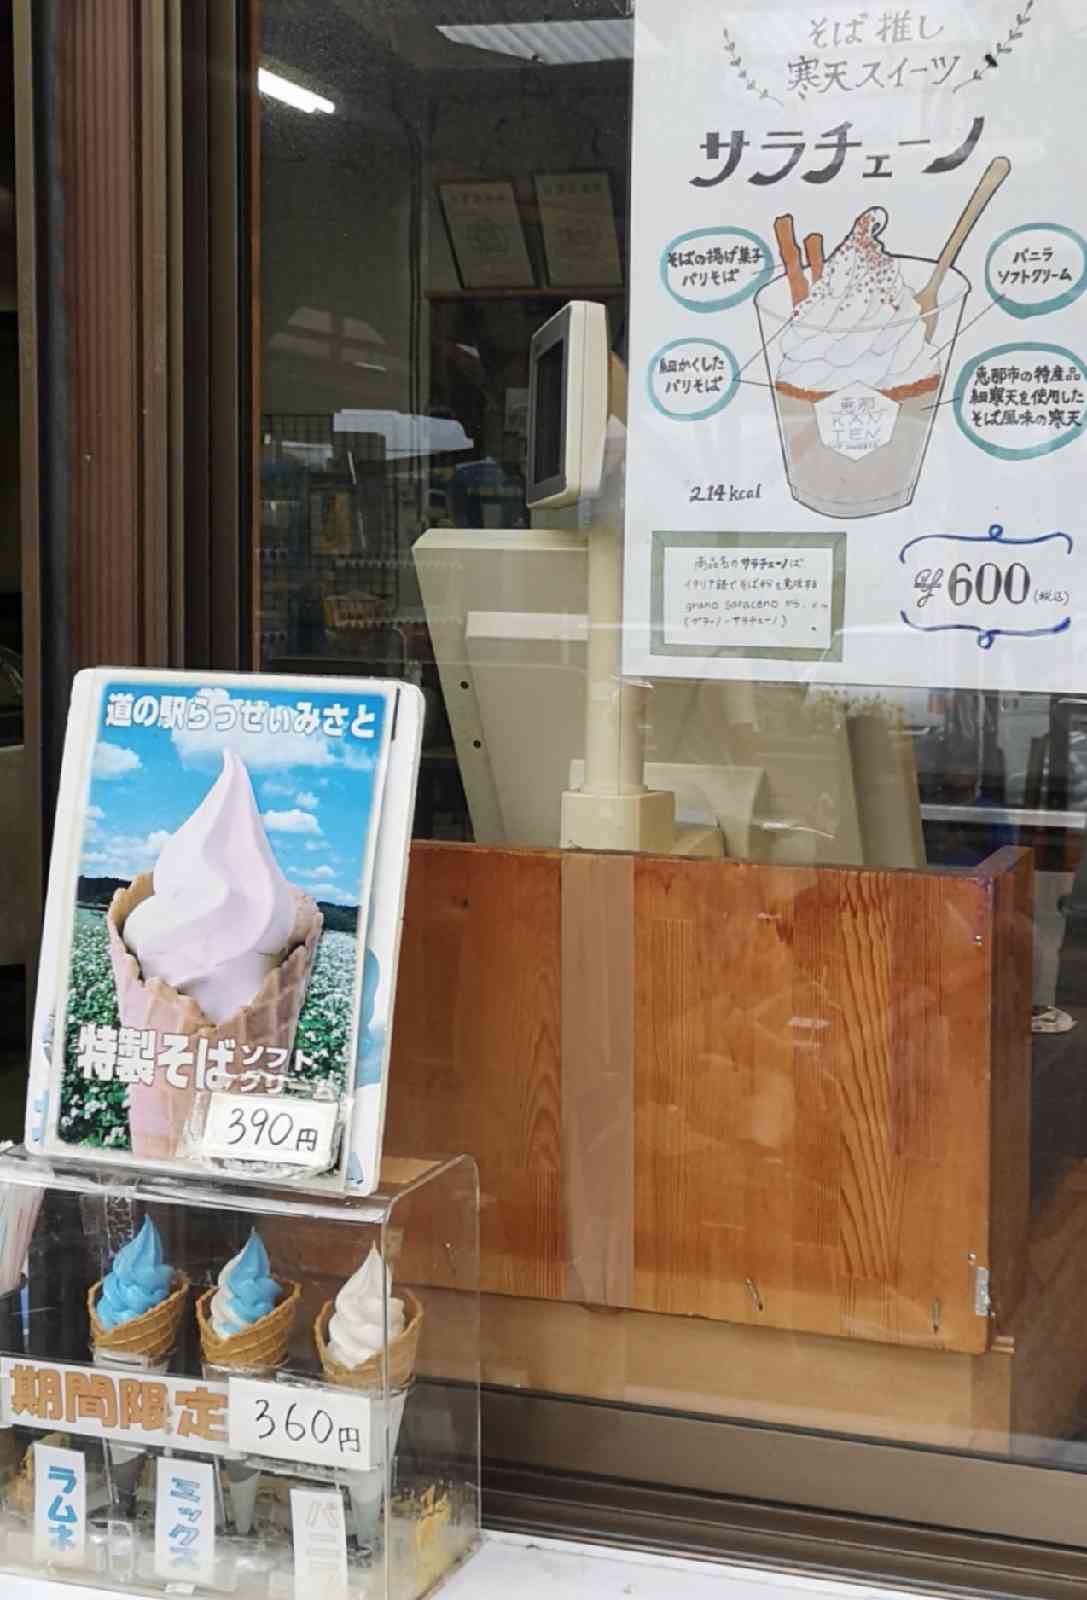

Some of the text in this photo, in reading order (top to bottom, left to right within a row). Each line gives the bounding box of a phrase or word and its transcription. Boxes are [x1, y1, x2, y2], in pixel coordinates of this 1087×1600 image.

[689, 116, 985, 188] サラチェーノ
[668, 245, 763, 268] そばの揚げ菓子
[997, 268, 1073, 285] ソフトクリーム
[659, 356, 725, 375] 細かくした
[969, 386, 1085, 407] 細寒天を使用した
[972, 408, 1083, 430] そば風味の寒天
[77, 1022, 236, 1091] 特製そば
[240, 1043, 314, 1071] ソフト
[227, 1106, 319, 1153] 390円
[9, 1363, 228, 1442] 期間限定
[255, 1399, 361, 1453] 360円
[48, 1465, 78, 1551] ラムネ
